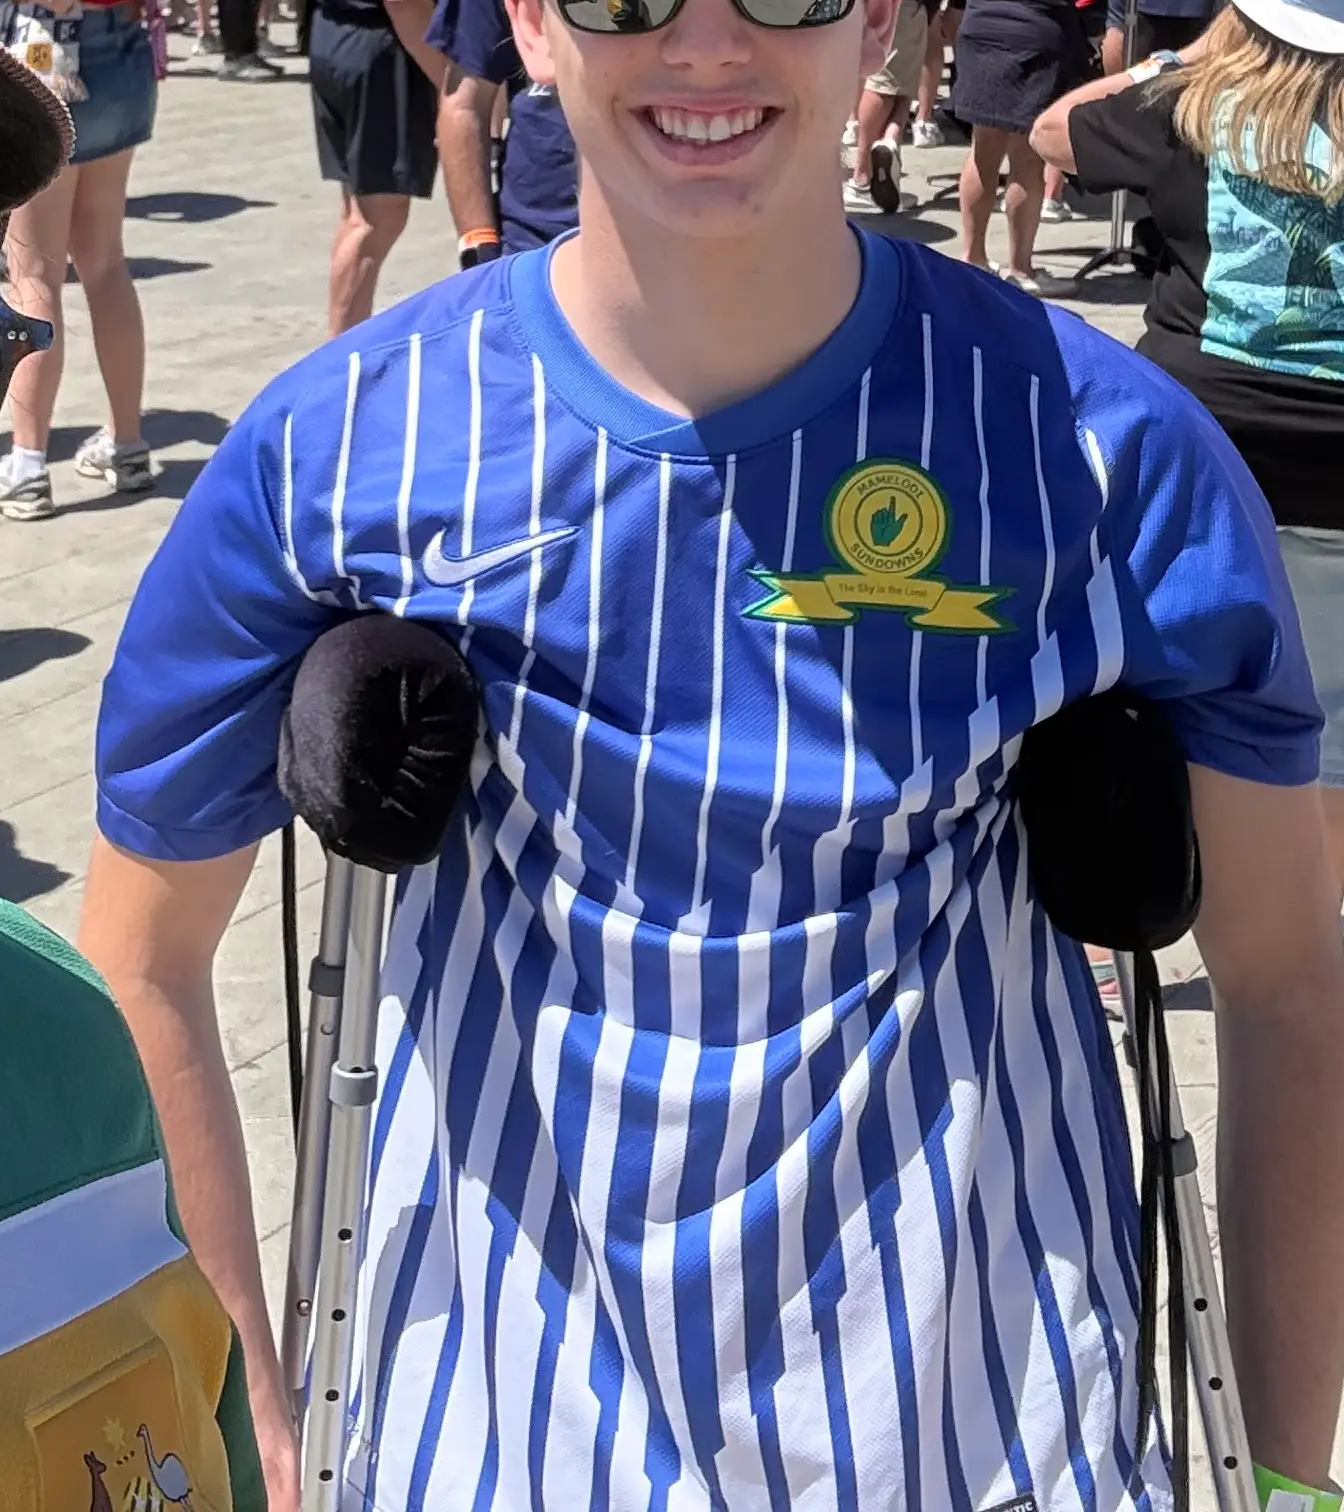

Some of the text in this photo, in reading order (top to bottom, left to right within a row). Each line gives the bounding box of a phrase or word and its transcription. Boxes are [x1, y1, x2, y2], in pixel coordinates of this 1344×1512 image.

[850, 543, 924, 570] SUNDOWNS
[838, 583, 855, 592] The
[857, 583, 875, 595] Sky
